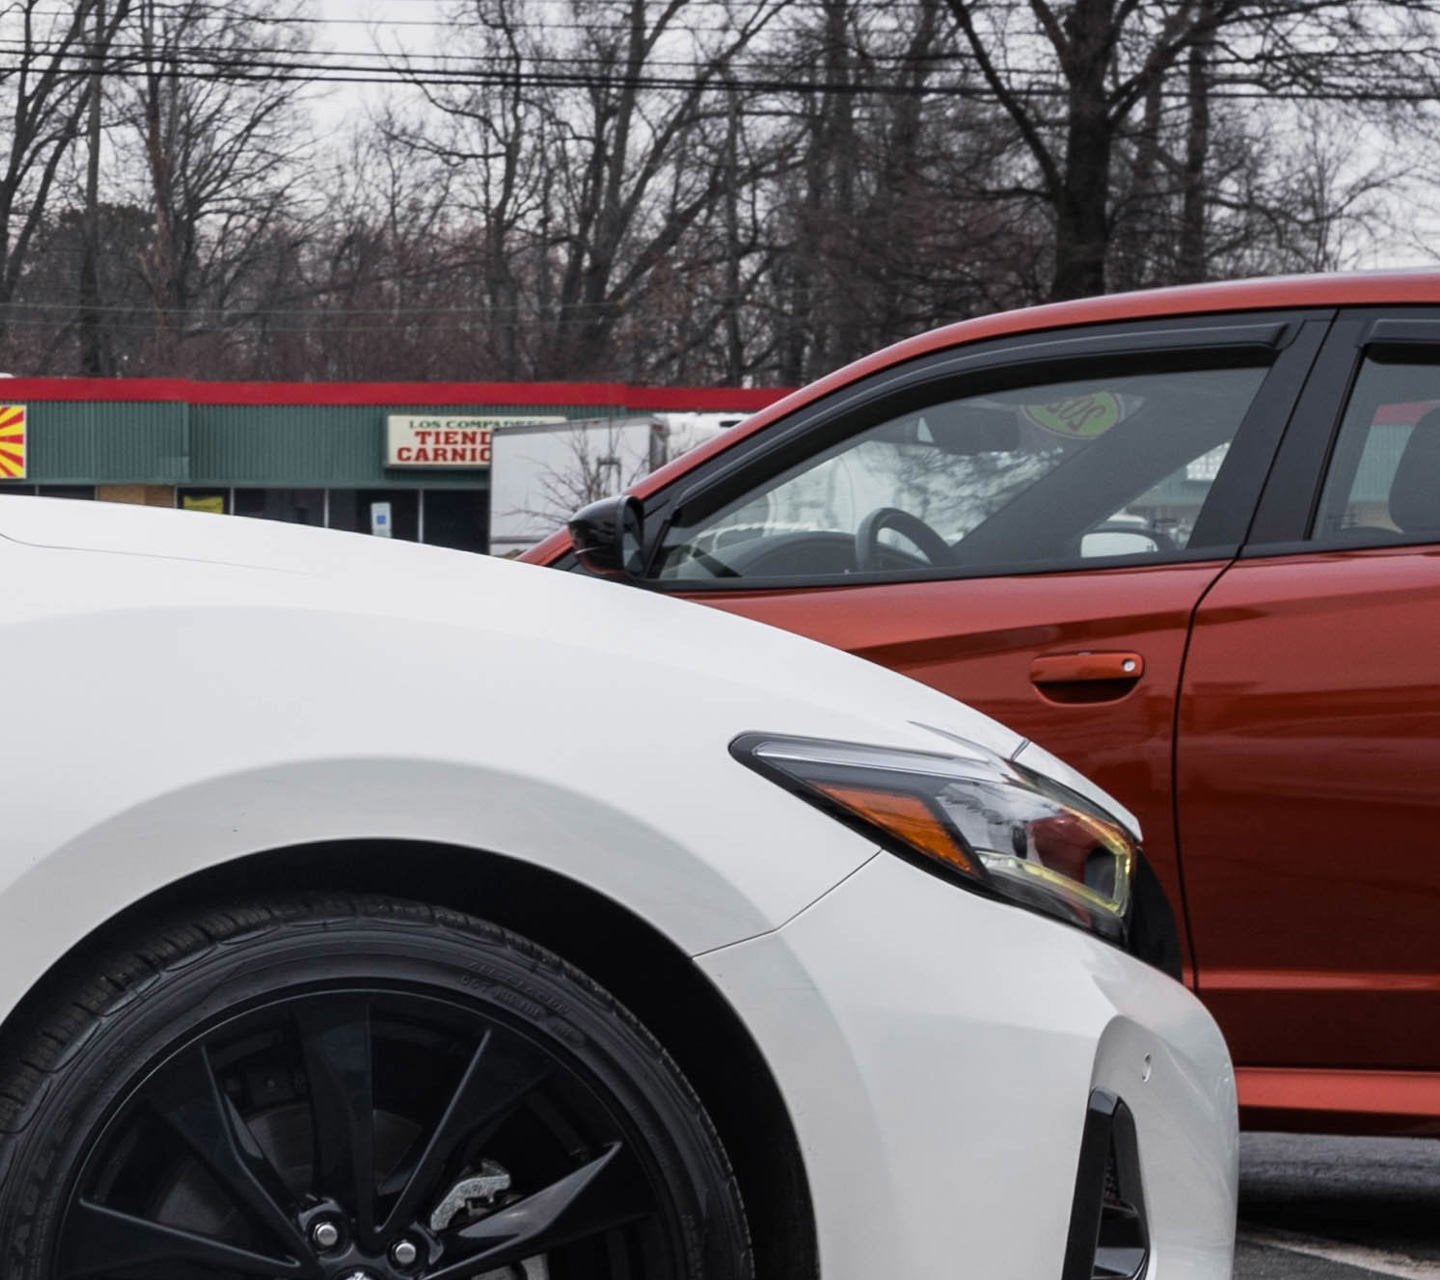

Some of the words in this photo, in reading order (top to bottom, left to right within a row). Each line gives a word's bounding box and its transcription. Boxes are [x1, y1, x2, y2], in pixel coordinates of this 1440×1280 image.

[409, 420, 441, 429] LOS
[414, 431, 491, 445] TIEND
[397, 447, 491, 462] CARNIC
